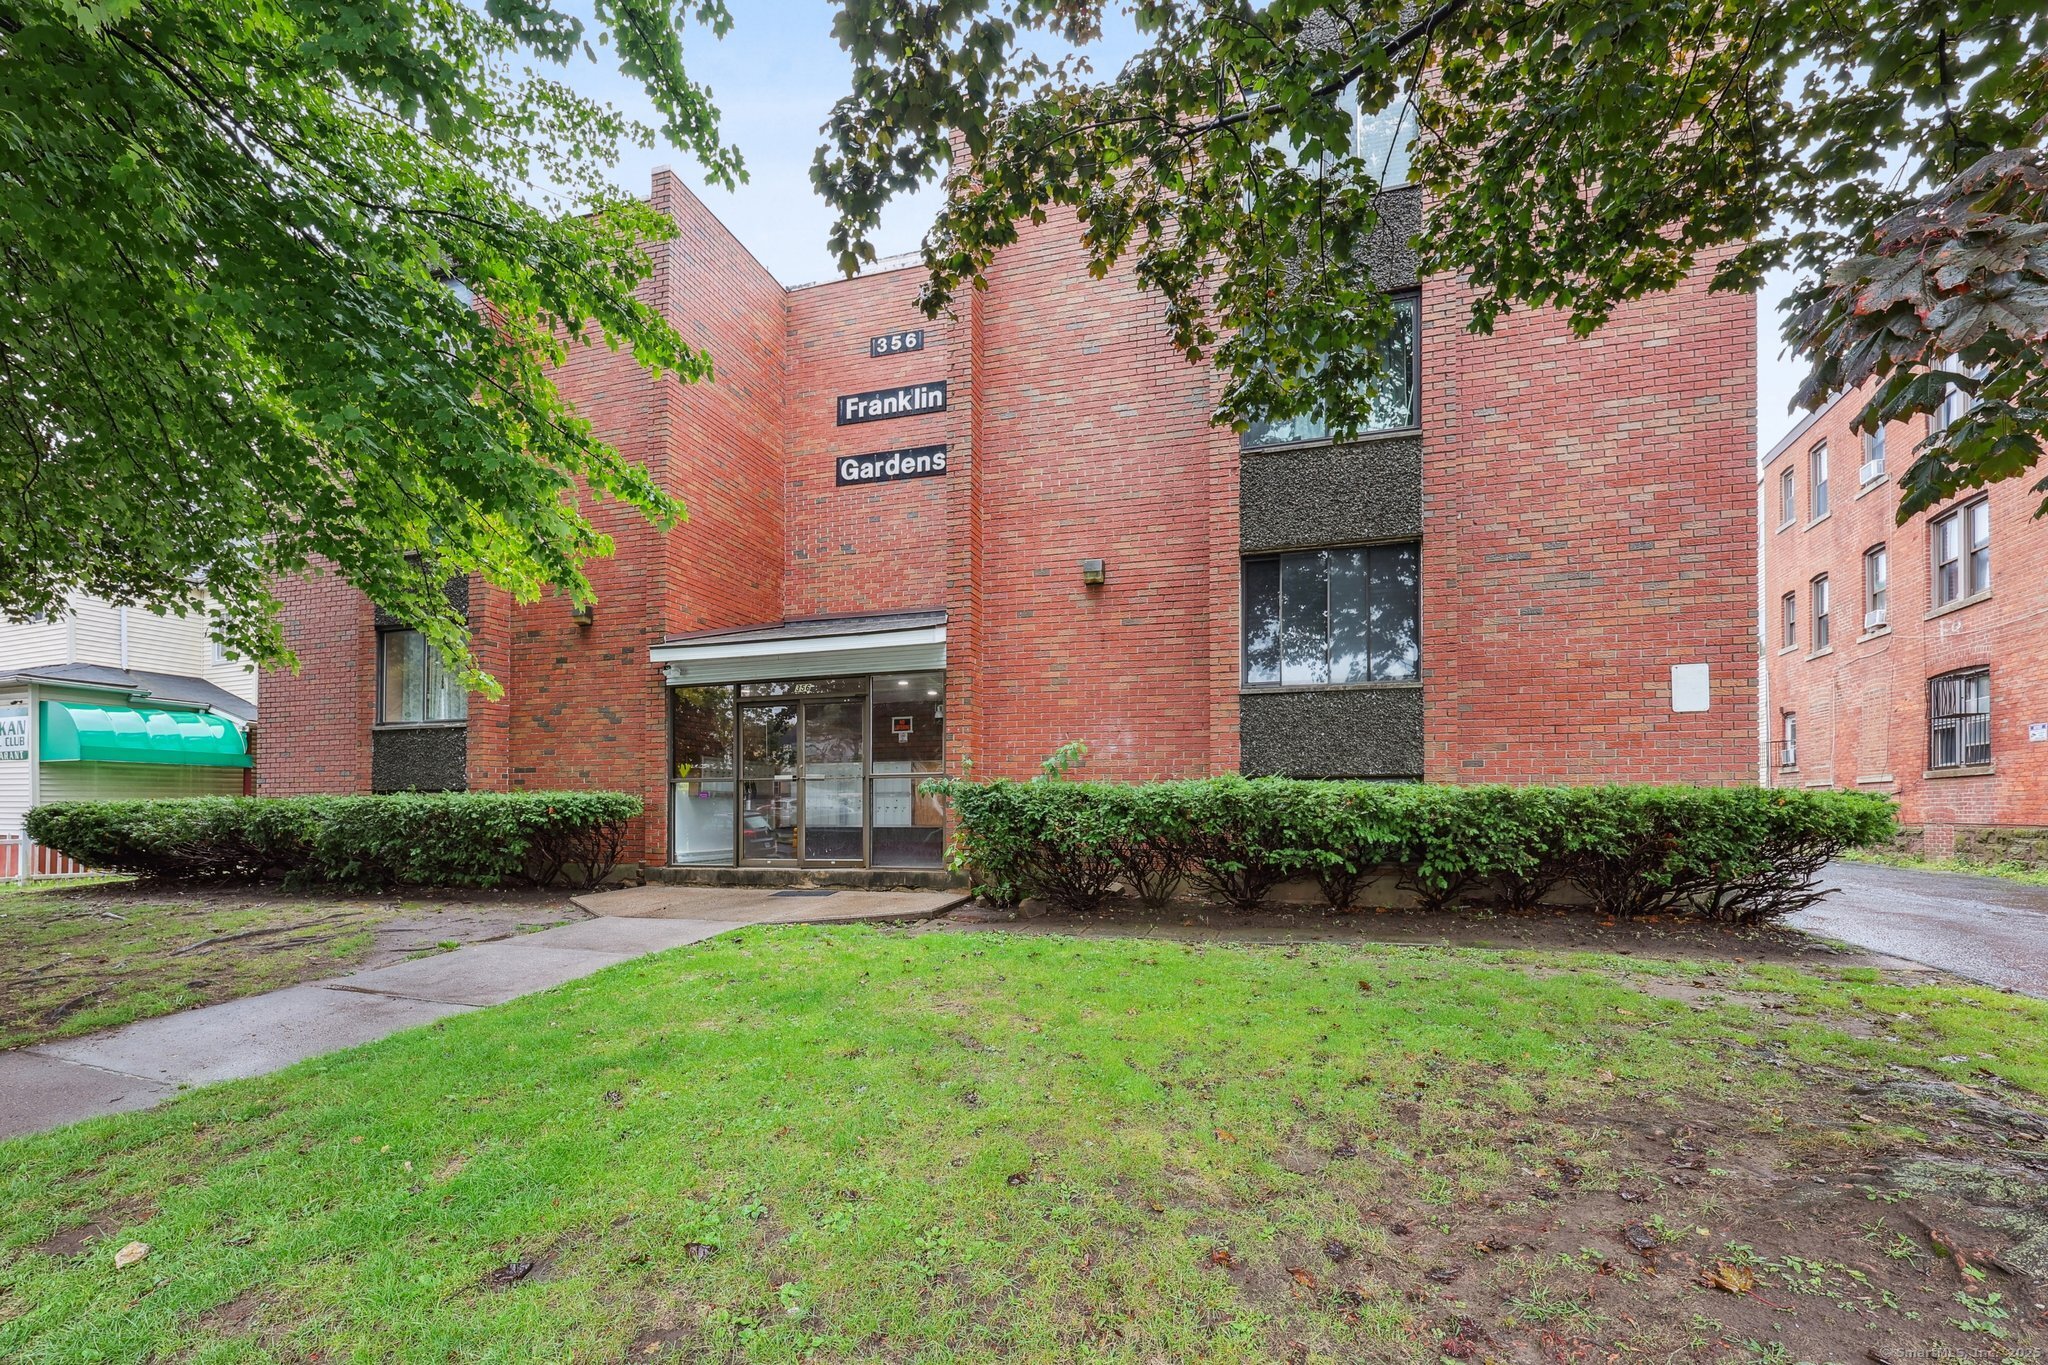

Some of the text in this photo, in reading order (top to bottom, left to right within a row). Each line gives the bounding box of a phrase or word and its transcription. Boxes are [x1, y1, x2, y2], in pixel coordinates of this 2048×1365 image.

[876, 333, 917, 353] 356
[846, 387, 943, 419] Franklin
[841, 453, 946, 480] Gardens
[795, 684, 811, 692] 356
[5, 737, 24, 746] CLUB
